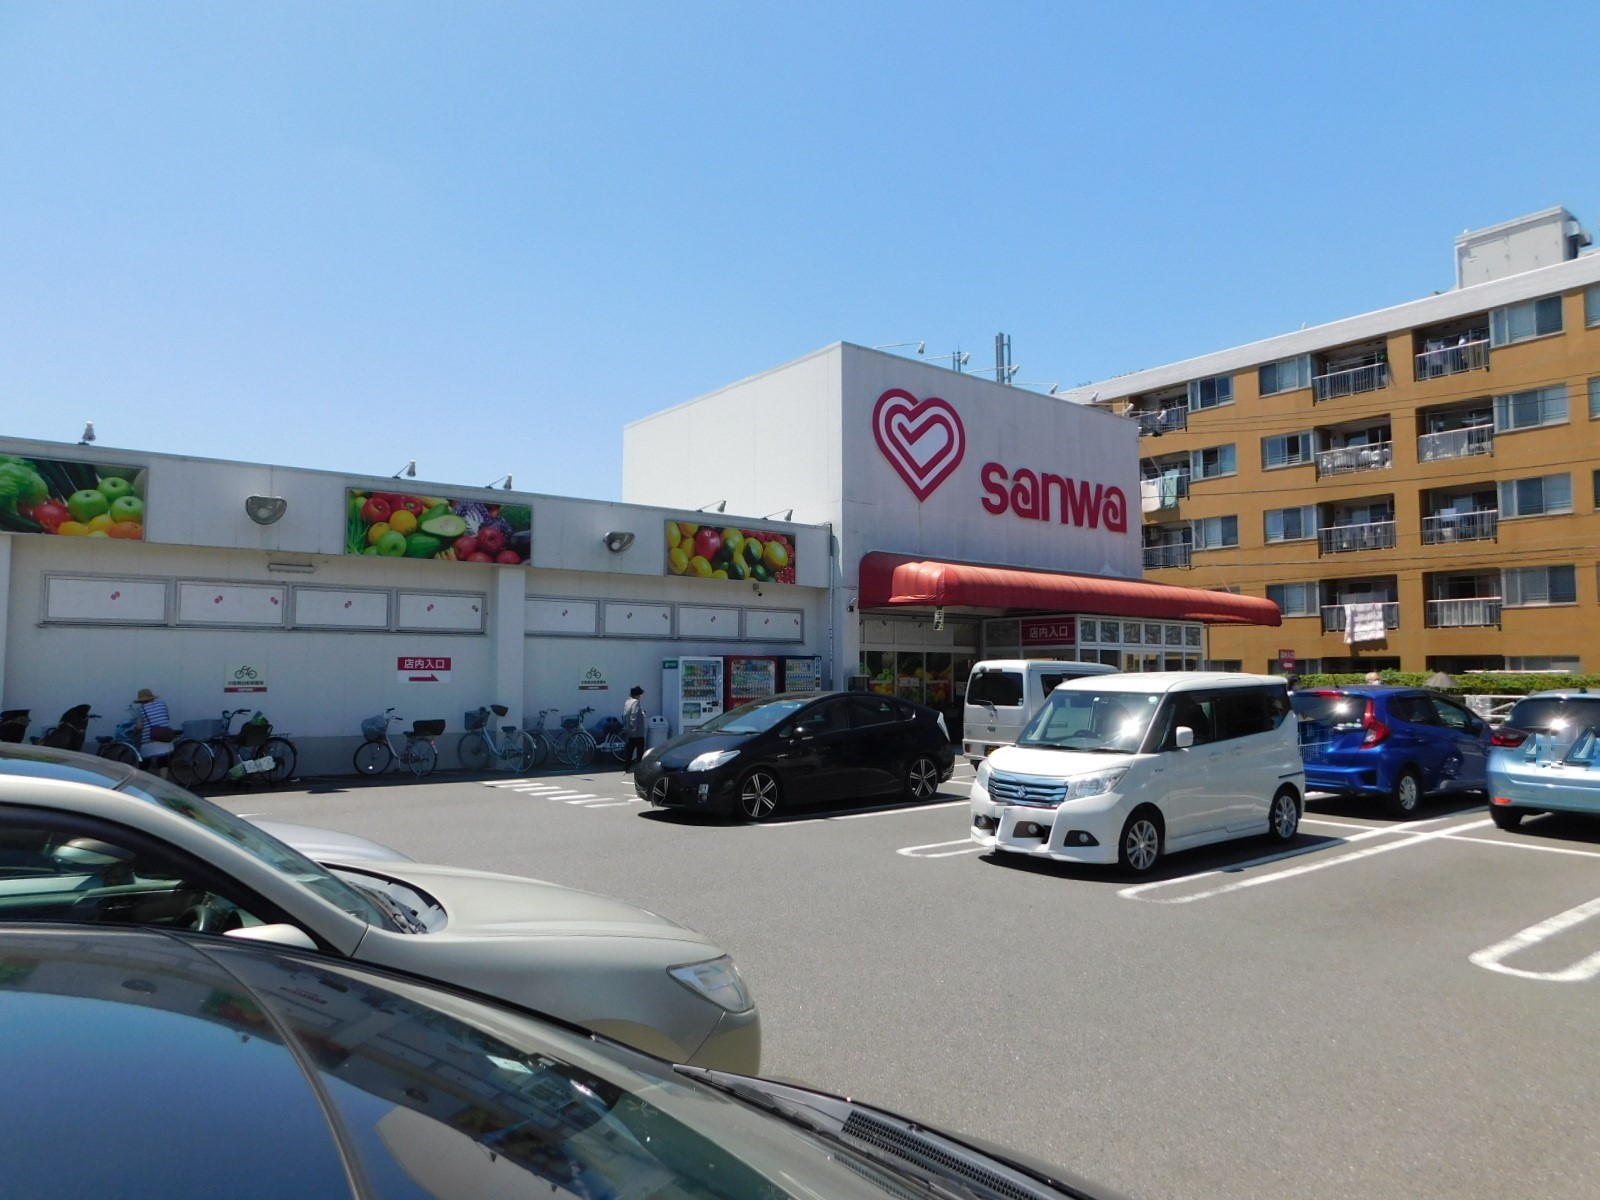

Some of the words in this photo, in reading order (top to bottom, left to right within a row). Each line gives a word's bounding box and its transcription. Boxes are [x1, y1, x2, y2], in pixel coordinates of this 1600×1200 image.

[1030, 625, 1068, 638] 店内入口
[404, 659, 445, 669] 店内入口
